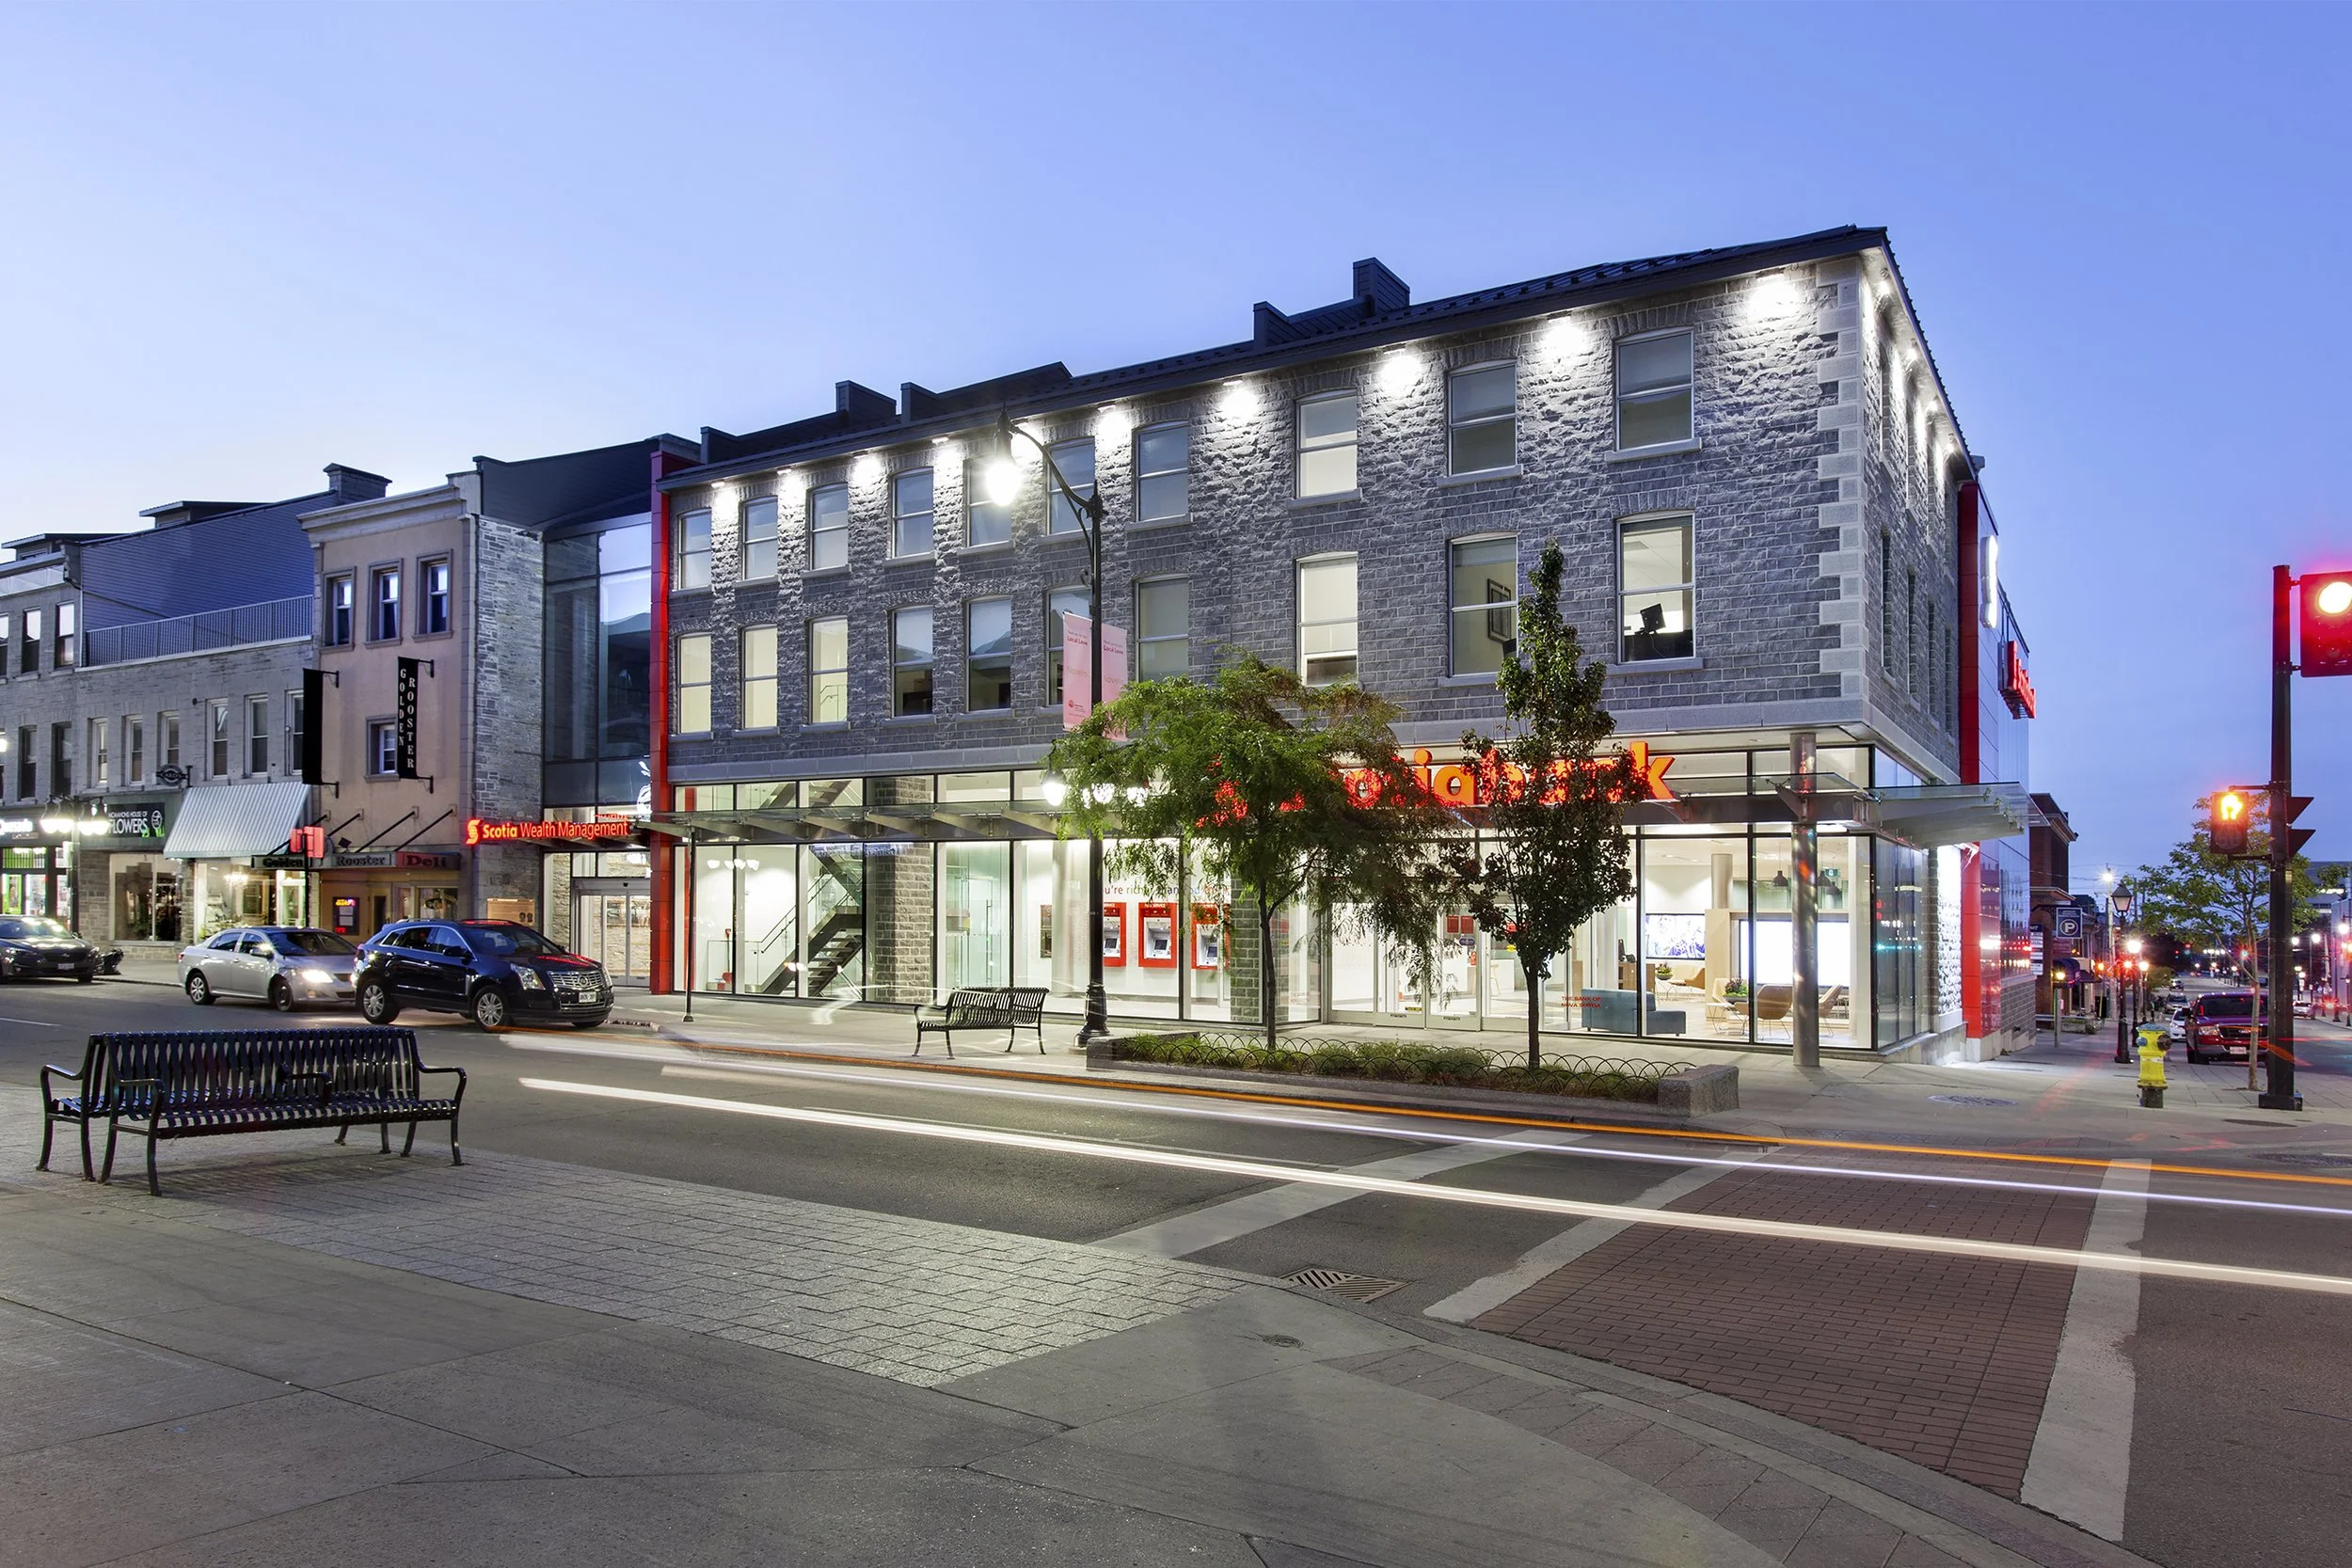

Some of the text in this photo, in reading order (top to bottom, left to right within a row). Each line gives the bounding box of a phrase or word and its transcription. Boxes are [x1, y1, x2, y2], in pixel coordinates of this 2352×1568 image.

[406, 677, 416, 768] ROOSTER
[108, 818, 148, 834] FLOWERS
[483, 820, 628, 840] Scotia Wealth Management
[337, 855, 386, 866] Rooster
[405, 854, 447, 866] Deli
[2064, 922, 2075, 933] P
